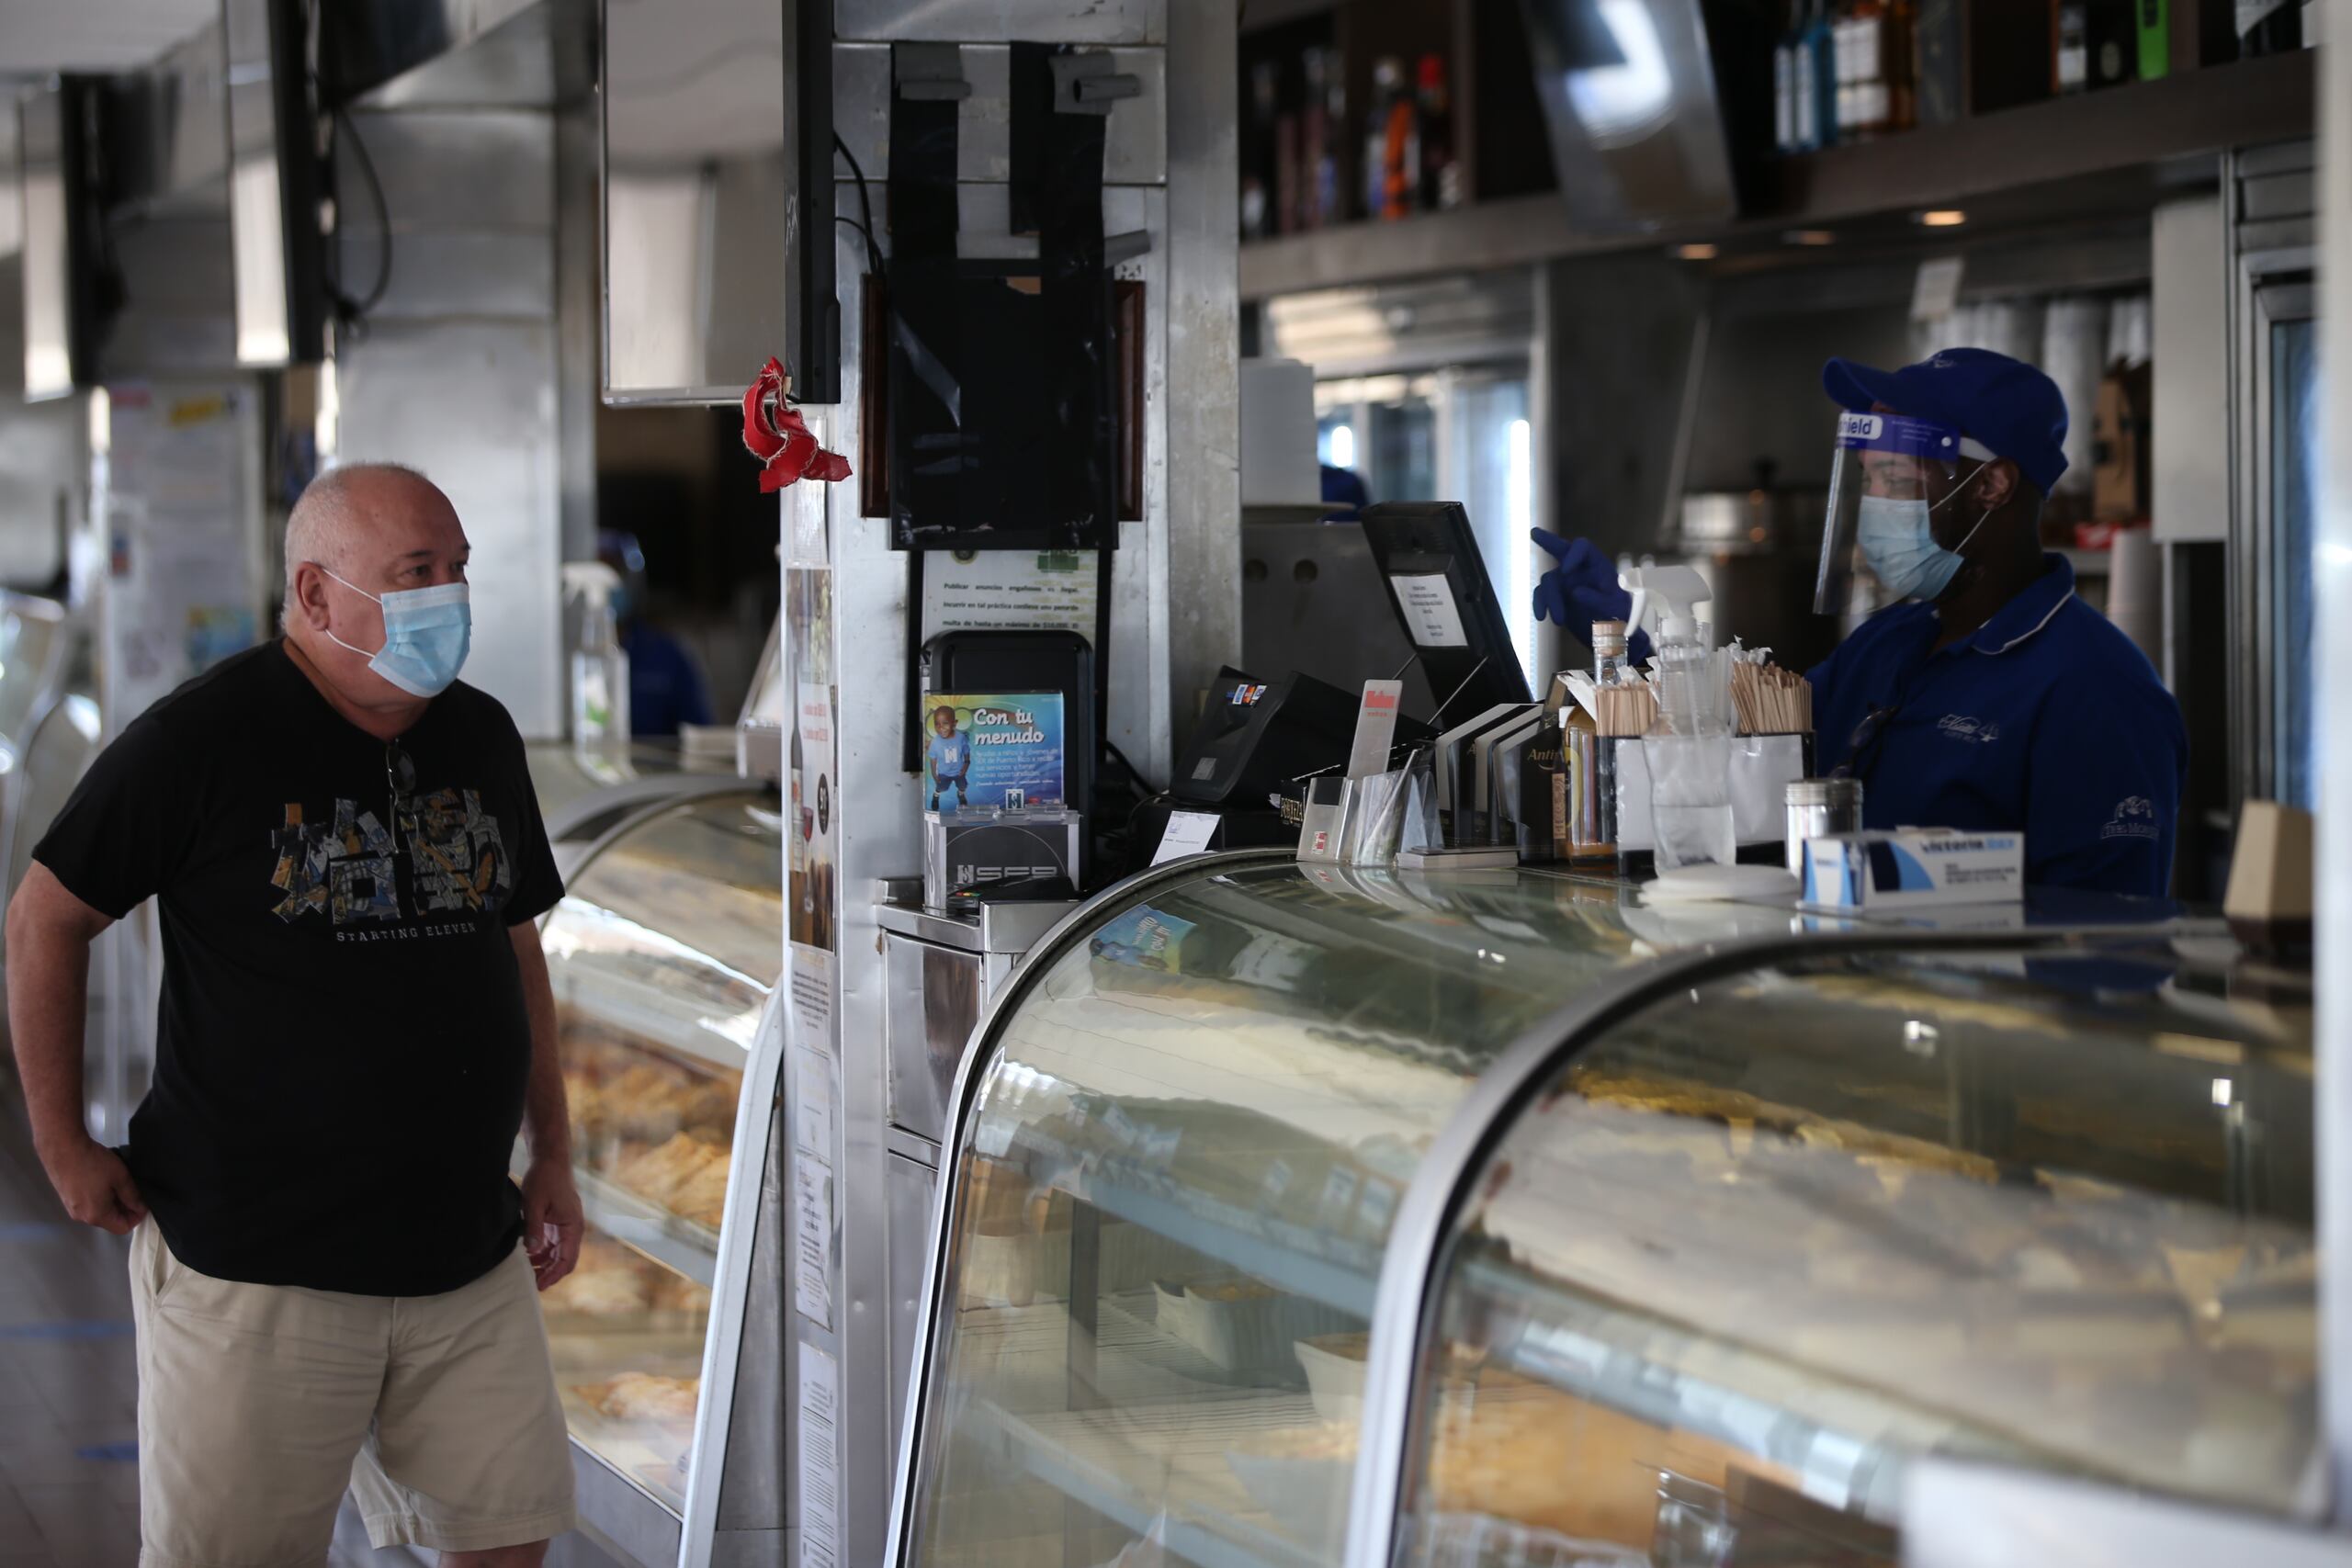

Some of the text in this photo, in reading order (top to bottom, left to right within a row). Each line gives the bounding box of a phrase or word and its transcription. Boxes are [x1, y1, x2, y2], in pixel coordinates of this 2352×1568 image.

[987, 602, 1012, 610] práctica
[974, 708, 1034, 725] Con tu
[975, 727, 1045, 745] menudo
[336, 921, 478, 942] STARTING ELEVEN
